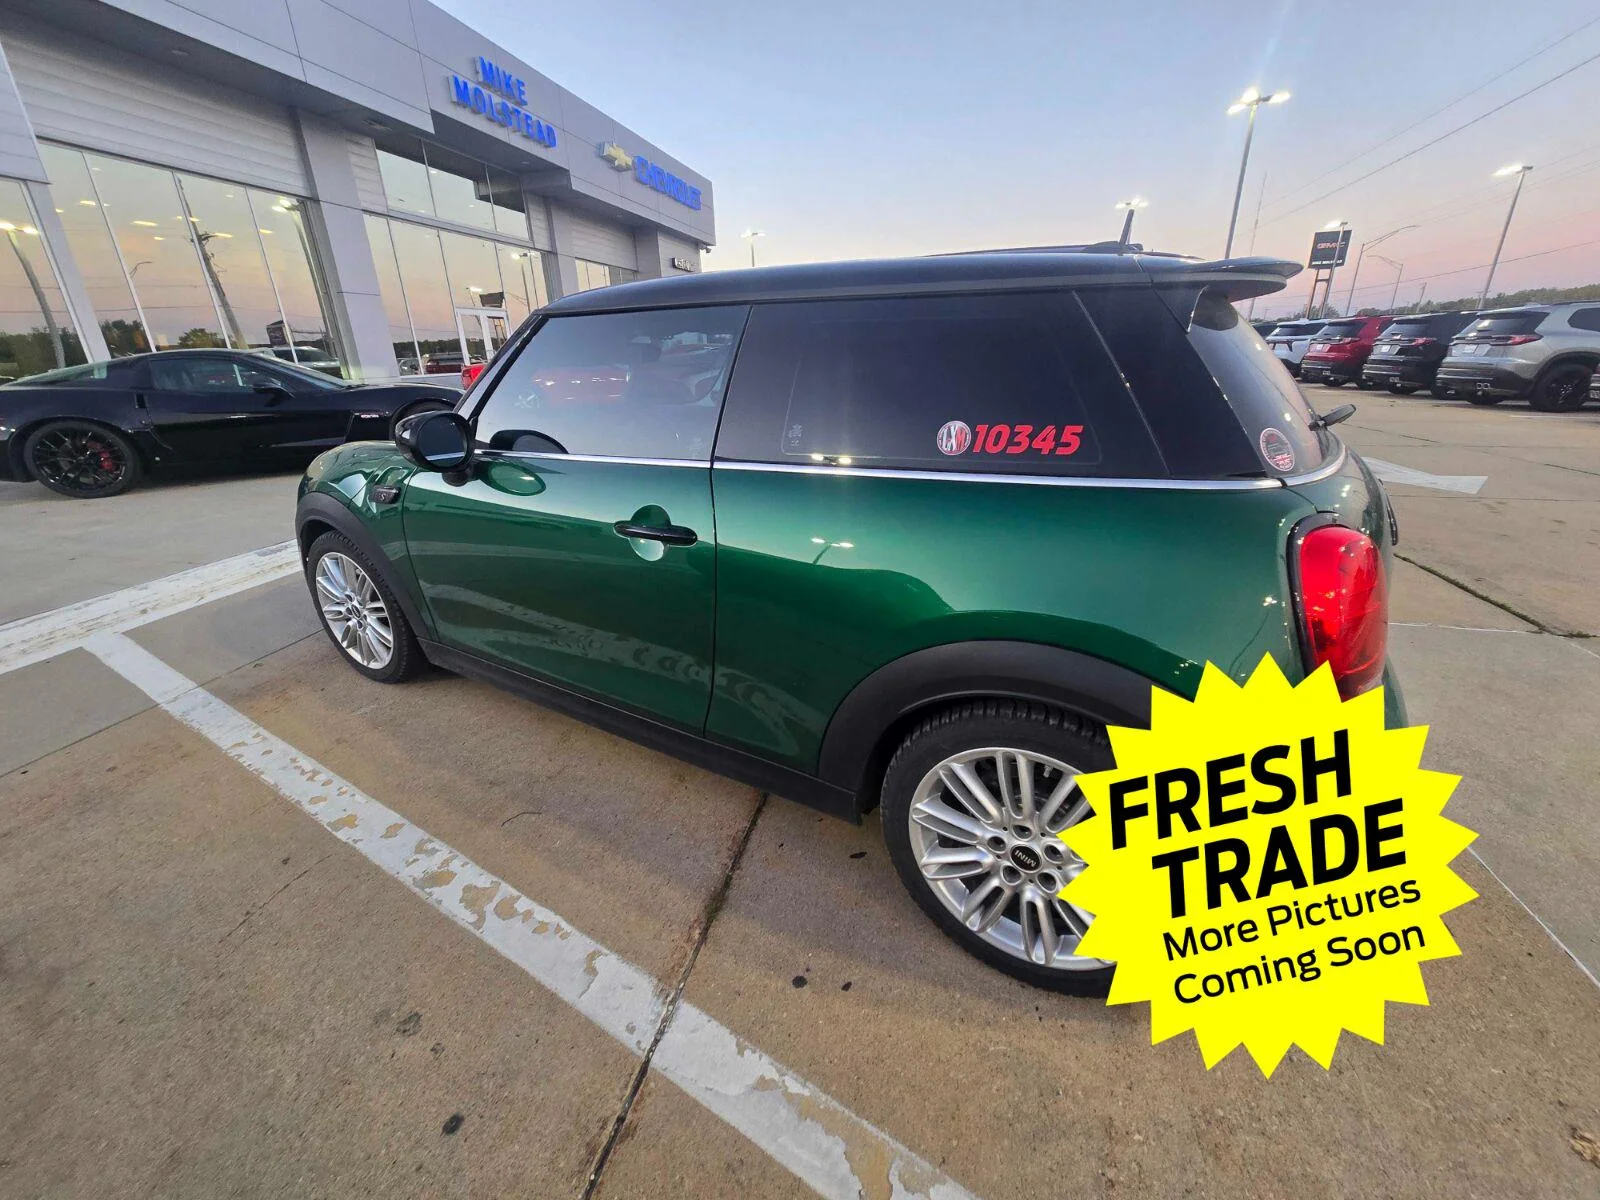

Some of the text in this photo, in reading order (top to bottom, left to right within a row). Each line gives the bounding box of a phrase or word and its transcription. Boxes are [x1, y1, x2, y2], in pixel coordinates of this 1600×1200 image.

[475, 55, 528, 106] MIKE
[448, 74, 557, 147] MOLSTEAD
[972, 424, 1083, 455] 10345
[1014, 850, 1036, 867] MINI
